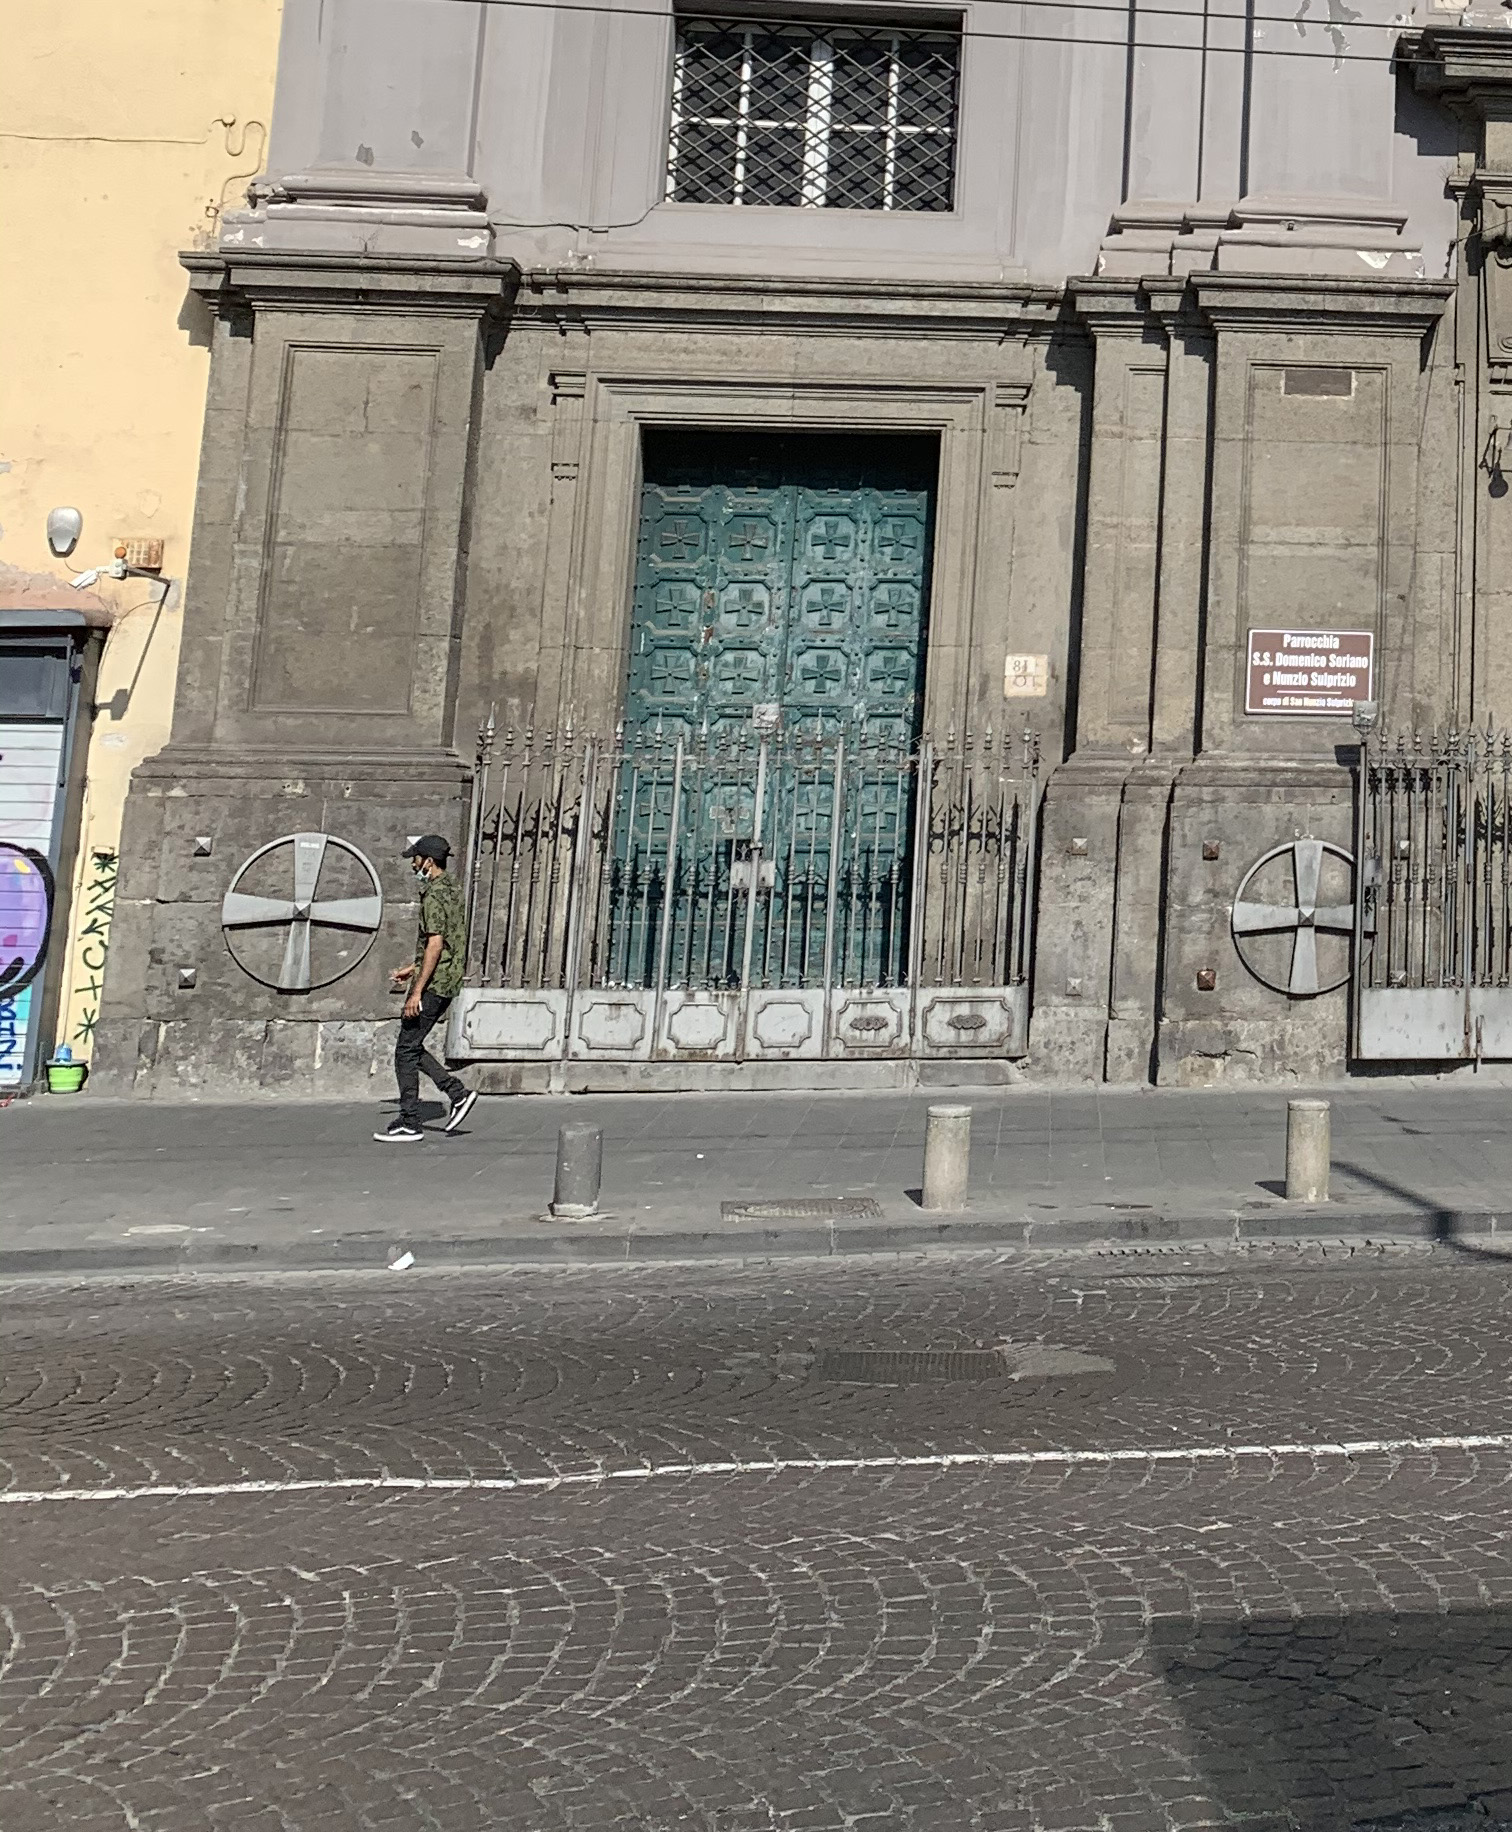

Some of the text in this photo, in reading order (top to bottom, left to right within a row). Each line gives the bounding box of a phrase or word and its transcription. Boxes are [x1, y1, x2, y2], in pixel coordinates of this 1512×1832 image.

[1283, 634, 1340, 649] Parrocchia
[1252, 652, 1369, 669] S.S. Domenico Soriano
[1263, 672, 1357, 688] e Nunzio Sulprizio
[1290, 696, 1303, 707] San
[1327, 697, 1354, 708] Sulprizi
